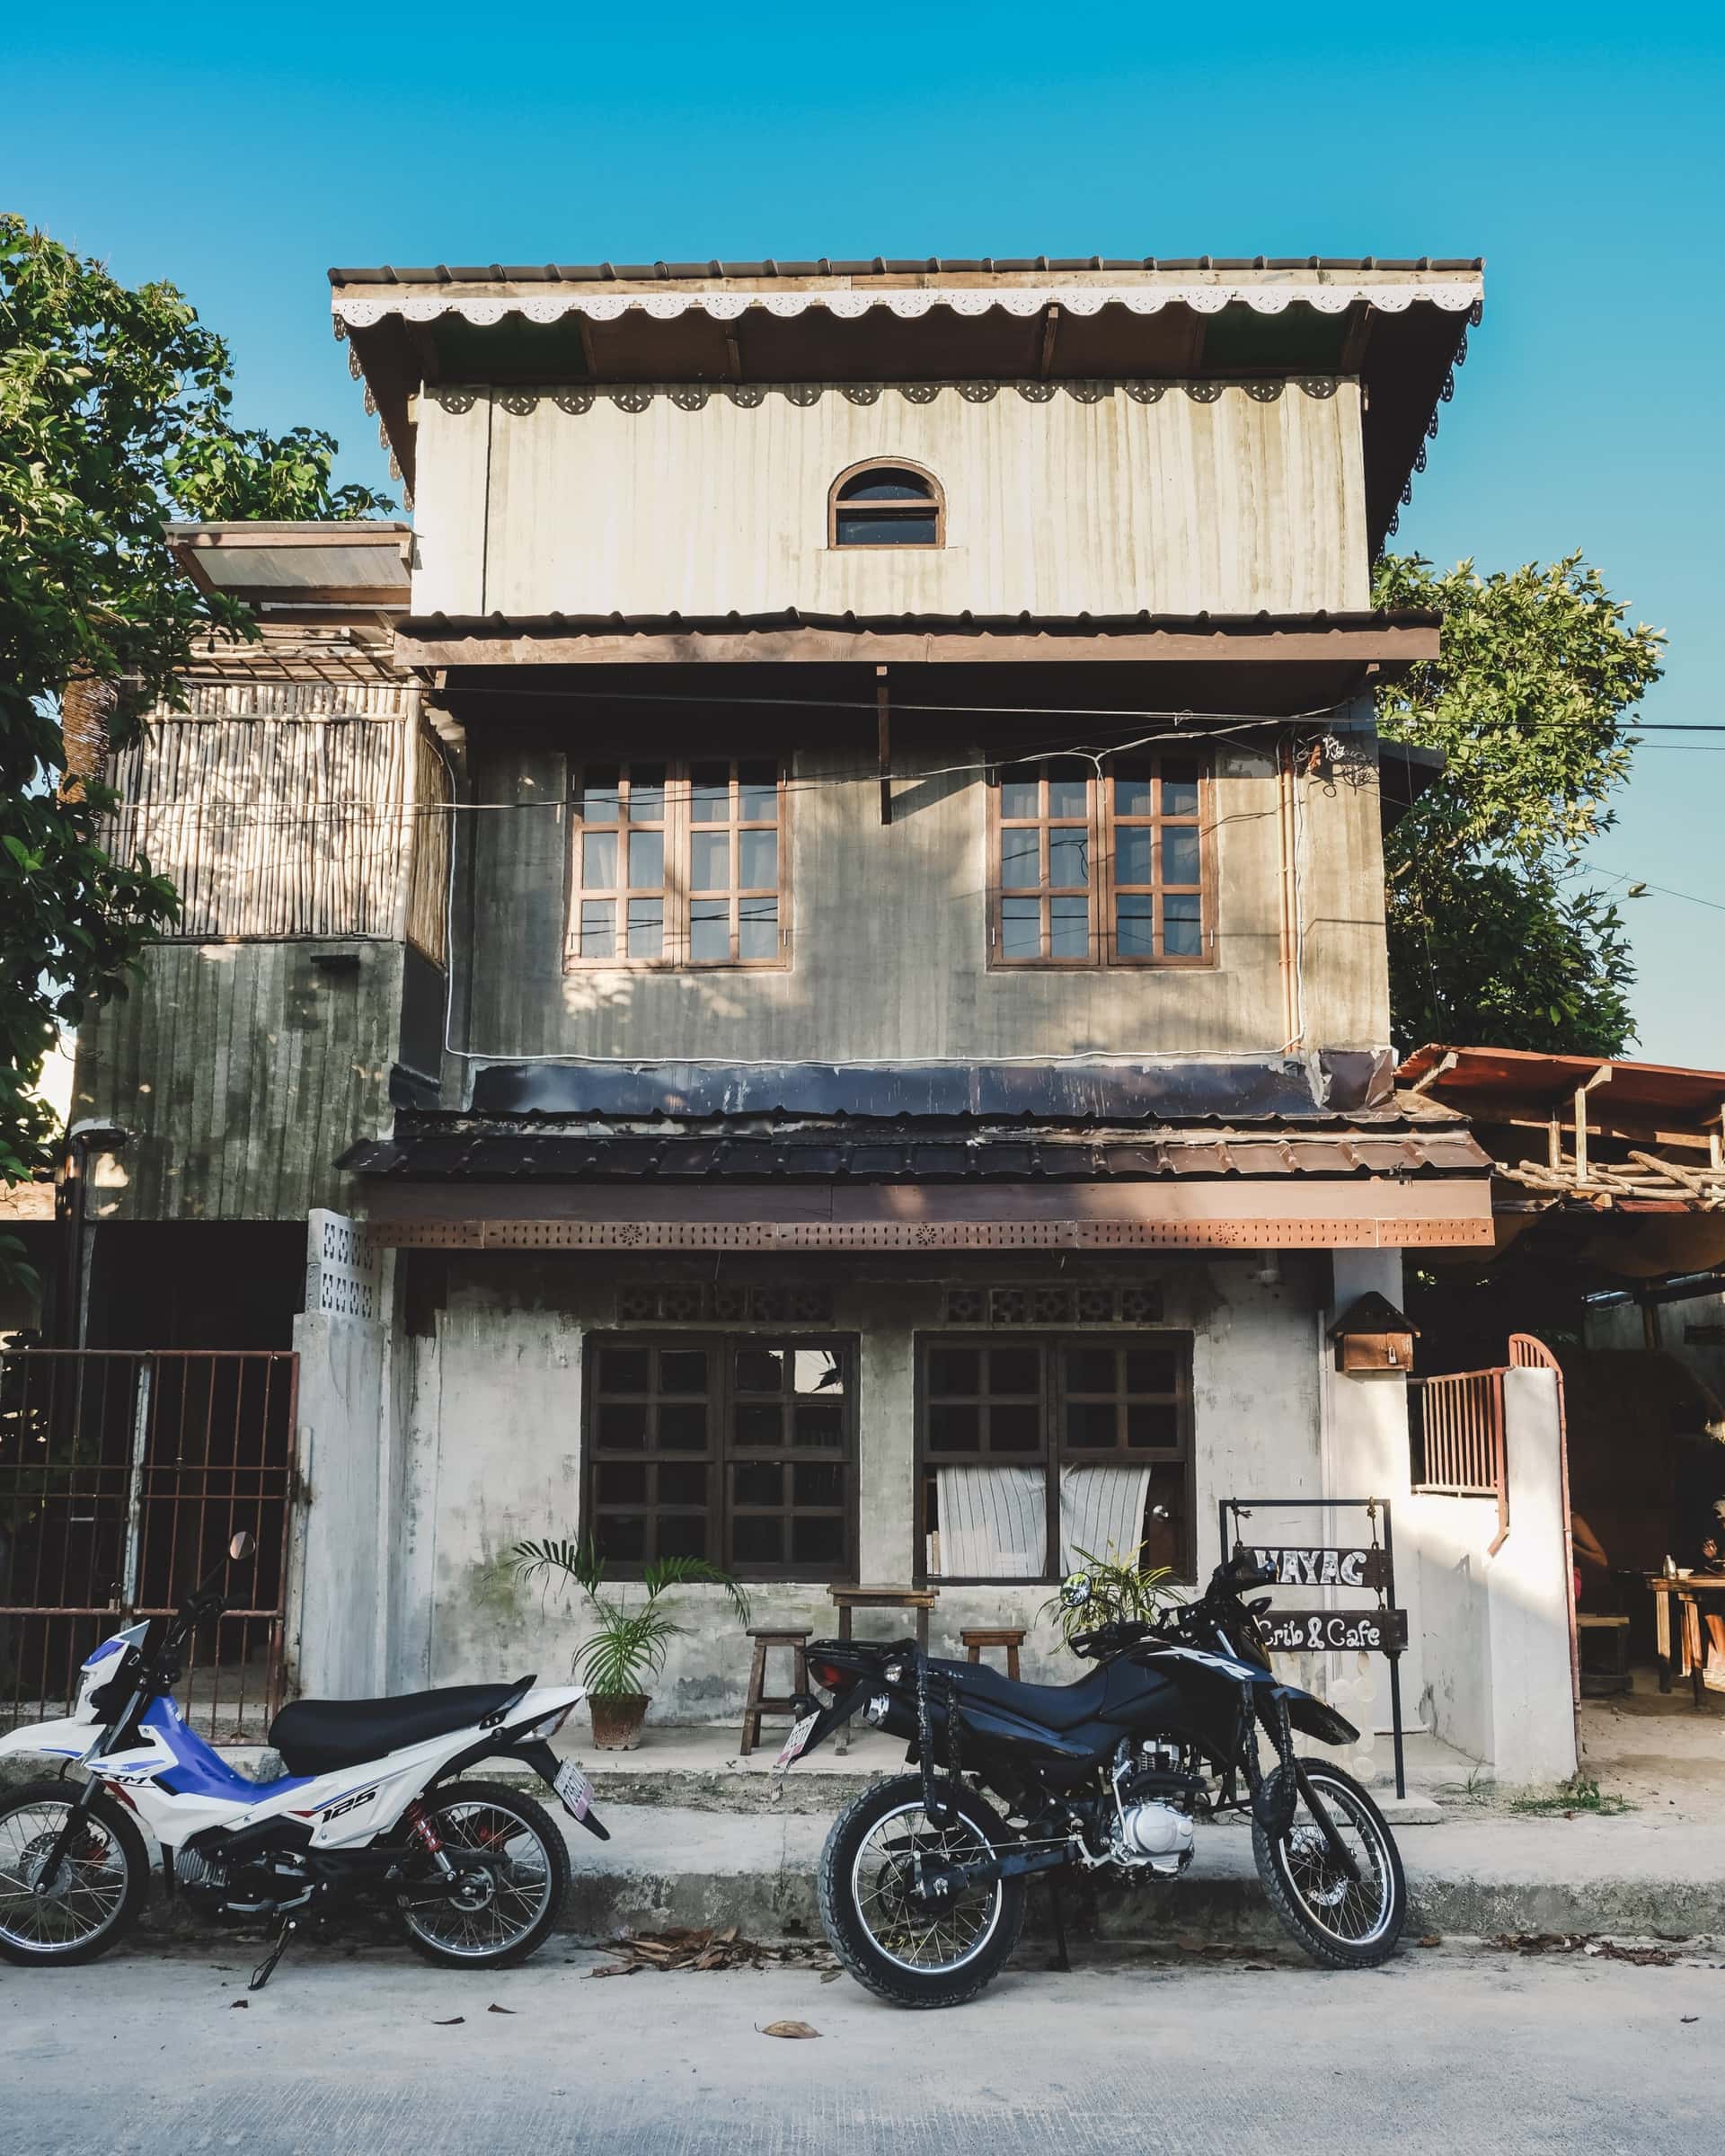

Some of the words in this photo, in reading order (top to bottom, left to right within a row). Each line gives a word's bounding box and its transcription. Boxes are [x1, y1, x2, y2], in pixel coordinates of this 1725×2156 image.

[1258, 1620, 1304, 1647] Crib
[1306, 1617, 1325, 1649] &
[1327, 1618, 1380, 1648] Cafe
[322, 1784, 381, 1825] 125
